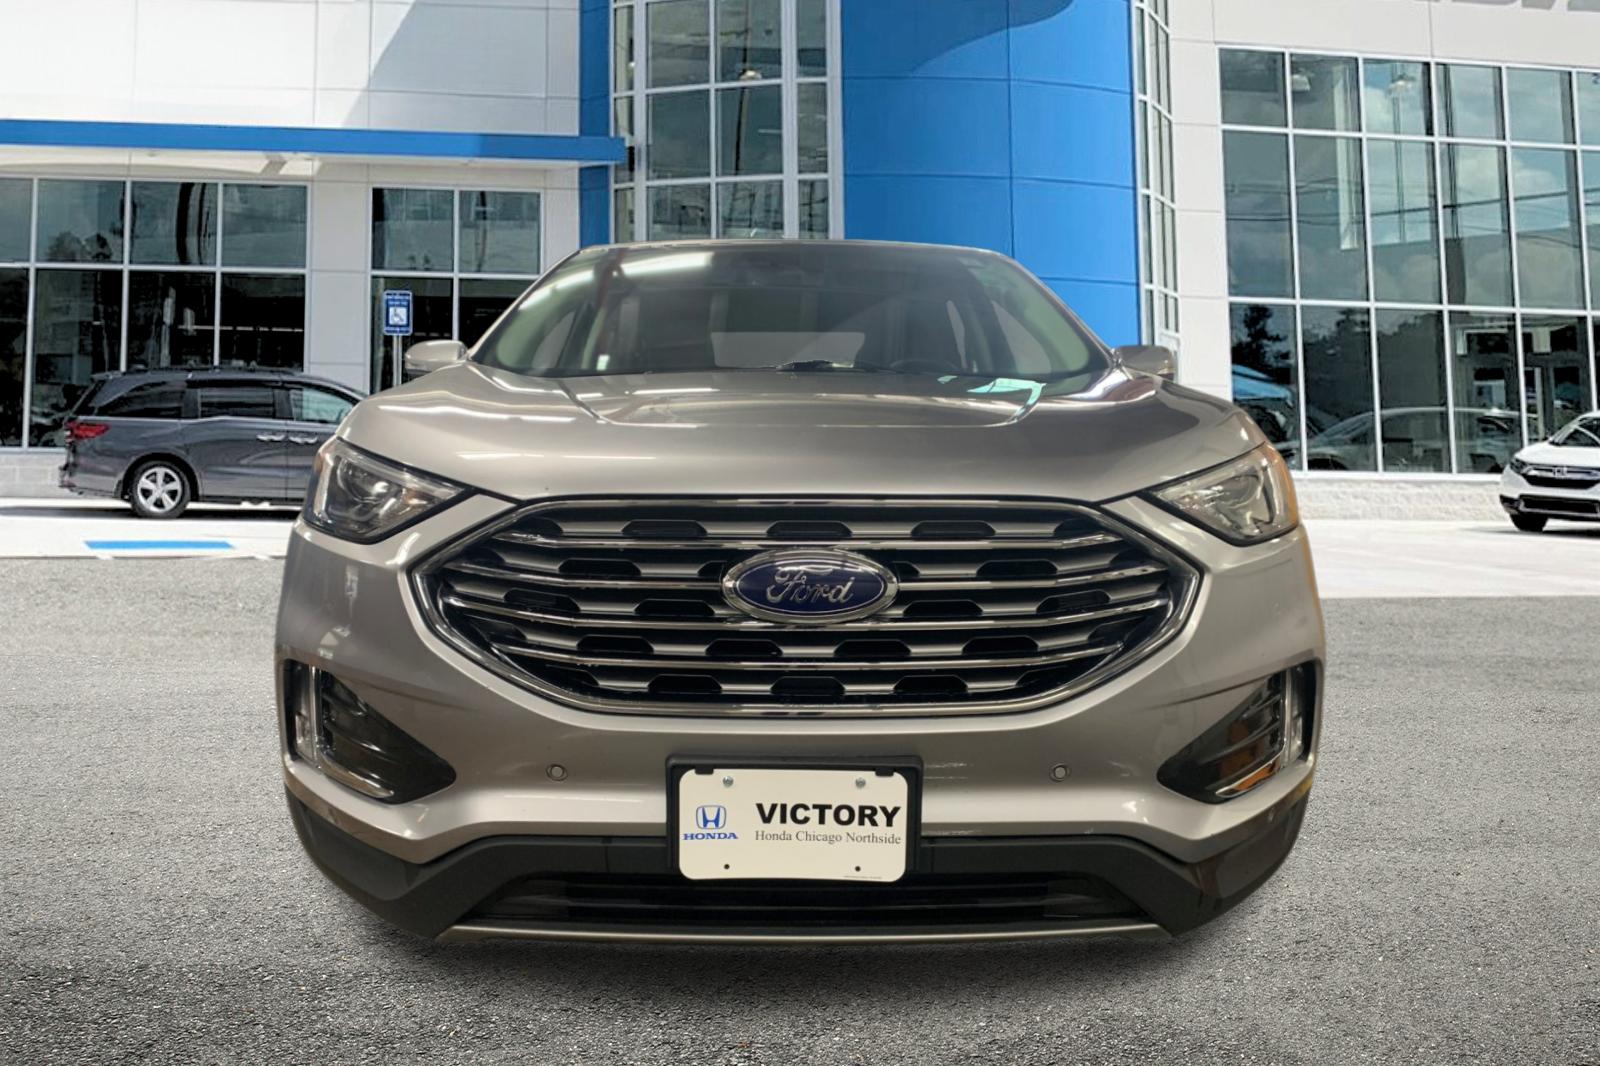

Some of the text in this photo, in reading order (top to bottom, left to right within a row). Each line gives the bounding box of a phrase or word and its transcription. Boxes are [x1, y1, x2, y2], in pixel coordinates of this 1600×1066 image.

[766, 566, 855, 603] Ford
[755, 803, 901, 827] VICTORY
[683, 832, 738, 840] HONDA
[755, 830, 901, 845] Honda Chicago Northside
